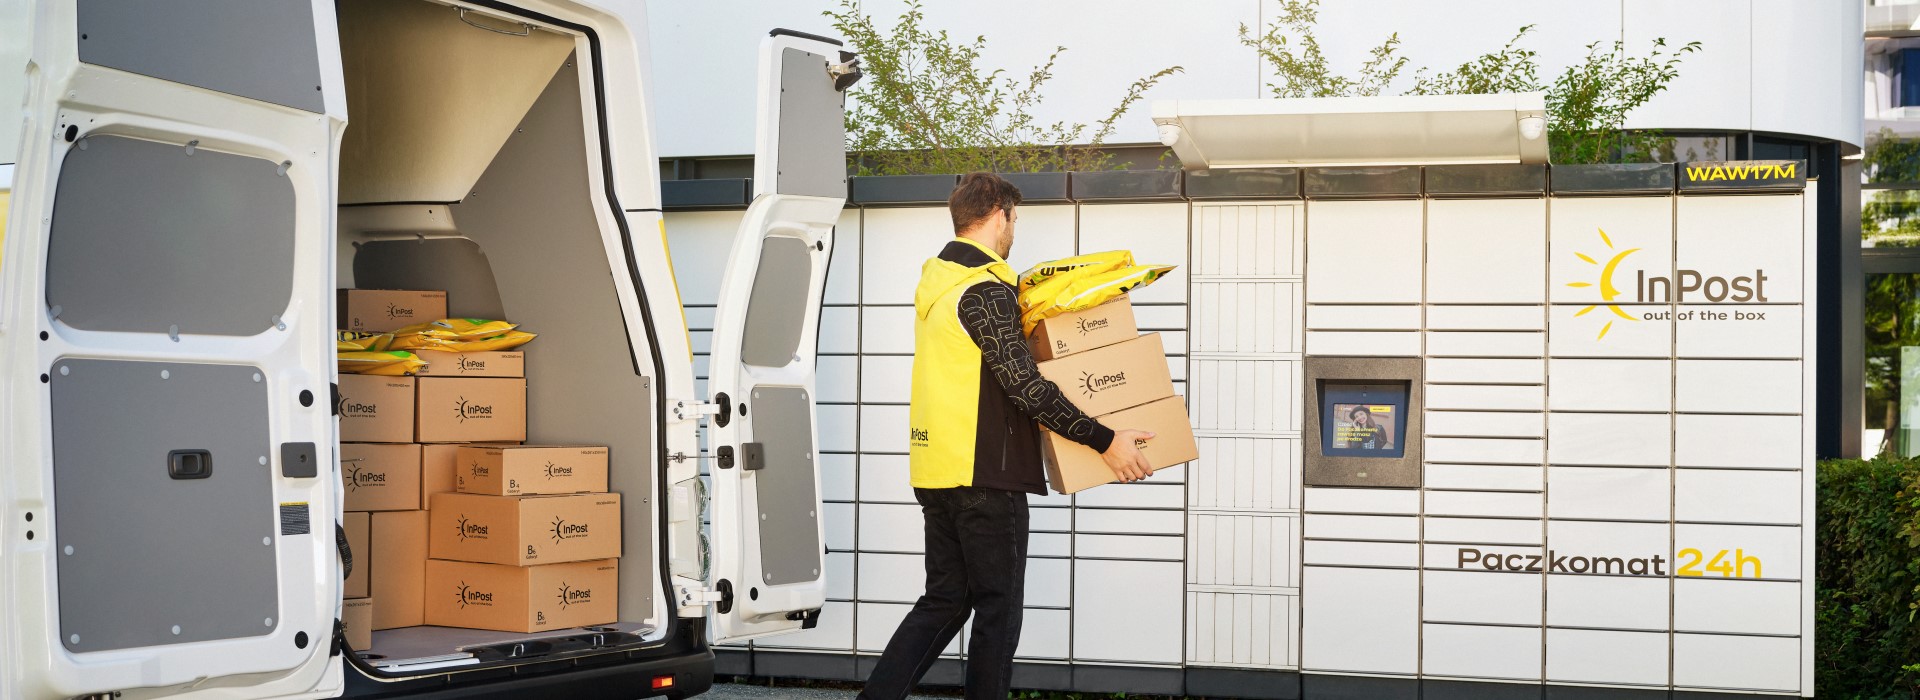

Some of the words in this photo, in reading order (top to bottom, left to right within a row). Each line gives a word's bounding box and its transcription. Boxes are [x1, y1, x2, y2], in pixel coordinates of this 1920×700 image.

[1686, 164, 1795, 181] WAW17M
[1637, 269, 1768, 302] InPost
[1643, 311, 1671, 321] out
[1677, 310, 1694, 321] of
[1700, 310, 1728, 321] the
[1735, 310, 1766, 321] box
[1087, 317, 1108, 329] InPost
[466, 360, 485, 368] InPost
[1094, 371, 1126, 387] InPost
[347, 403, 377, 413] InPost
[467, 405, 492, 414] InPost
[553, 466, 573, 474] InPost
[359, 473, 386, 482] InPost
[467, 524, 488, 535] InPost
[563, 523, 588, 535] InPost
[1458, 547, 1666, 575] Paczkomat
[1677, 547, 1762, 578] 24h
[468, 590, 493, 602] InPost
[569, 588, 591, 600] InPost
